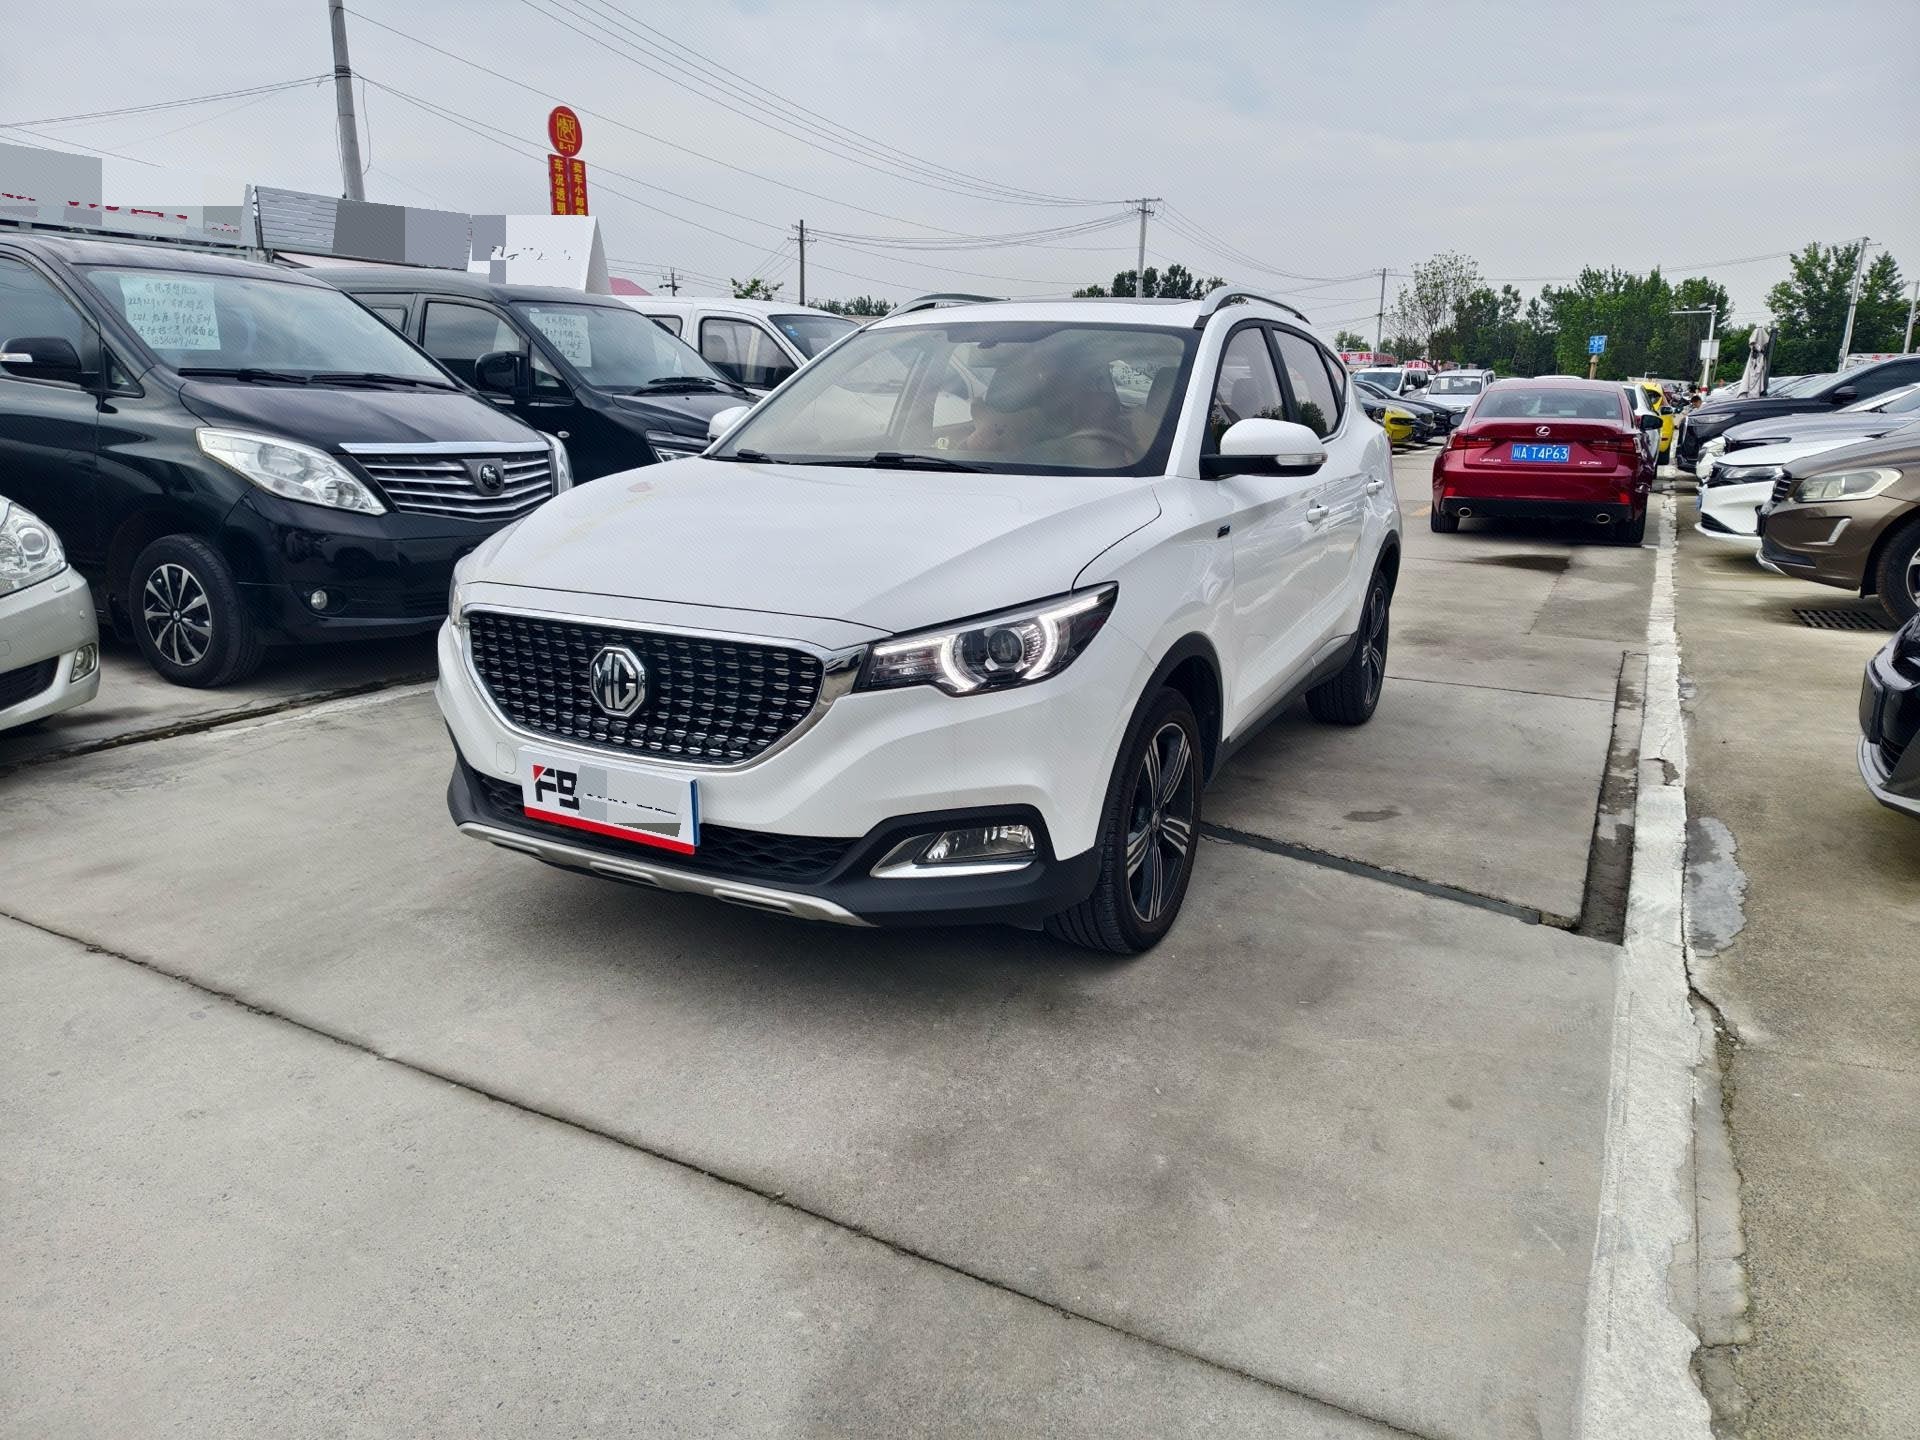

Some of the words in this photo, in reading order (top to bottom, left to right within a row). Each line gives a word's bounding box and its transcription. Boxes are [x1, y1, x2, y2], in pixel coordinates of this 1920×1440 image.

[554, 158, 566, 215] 车况透明
[593, 652, 637, 710] MG
